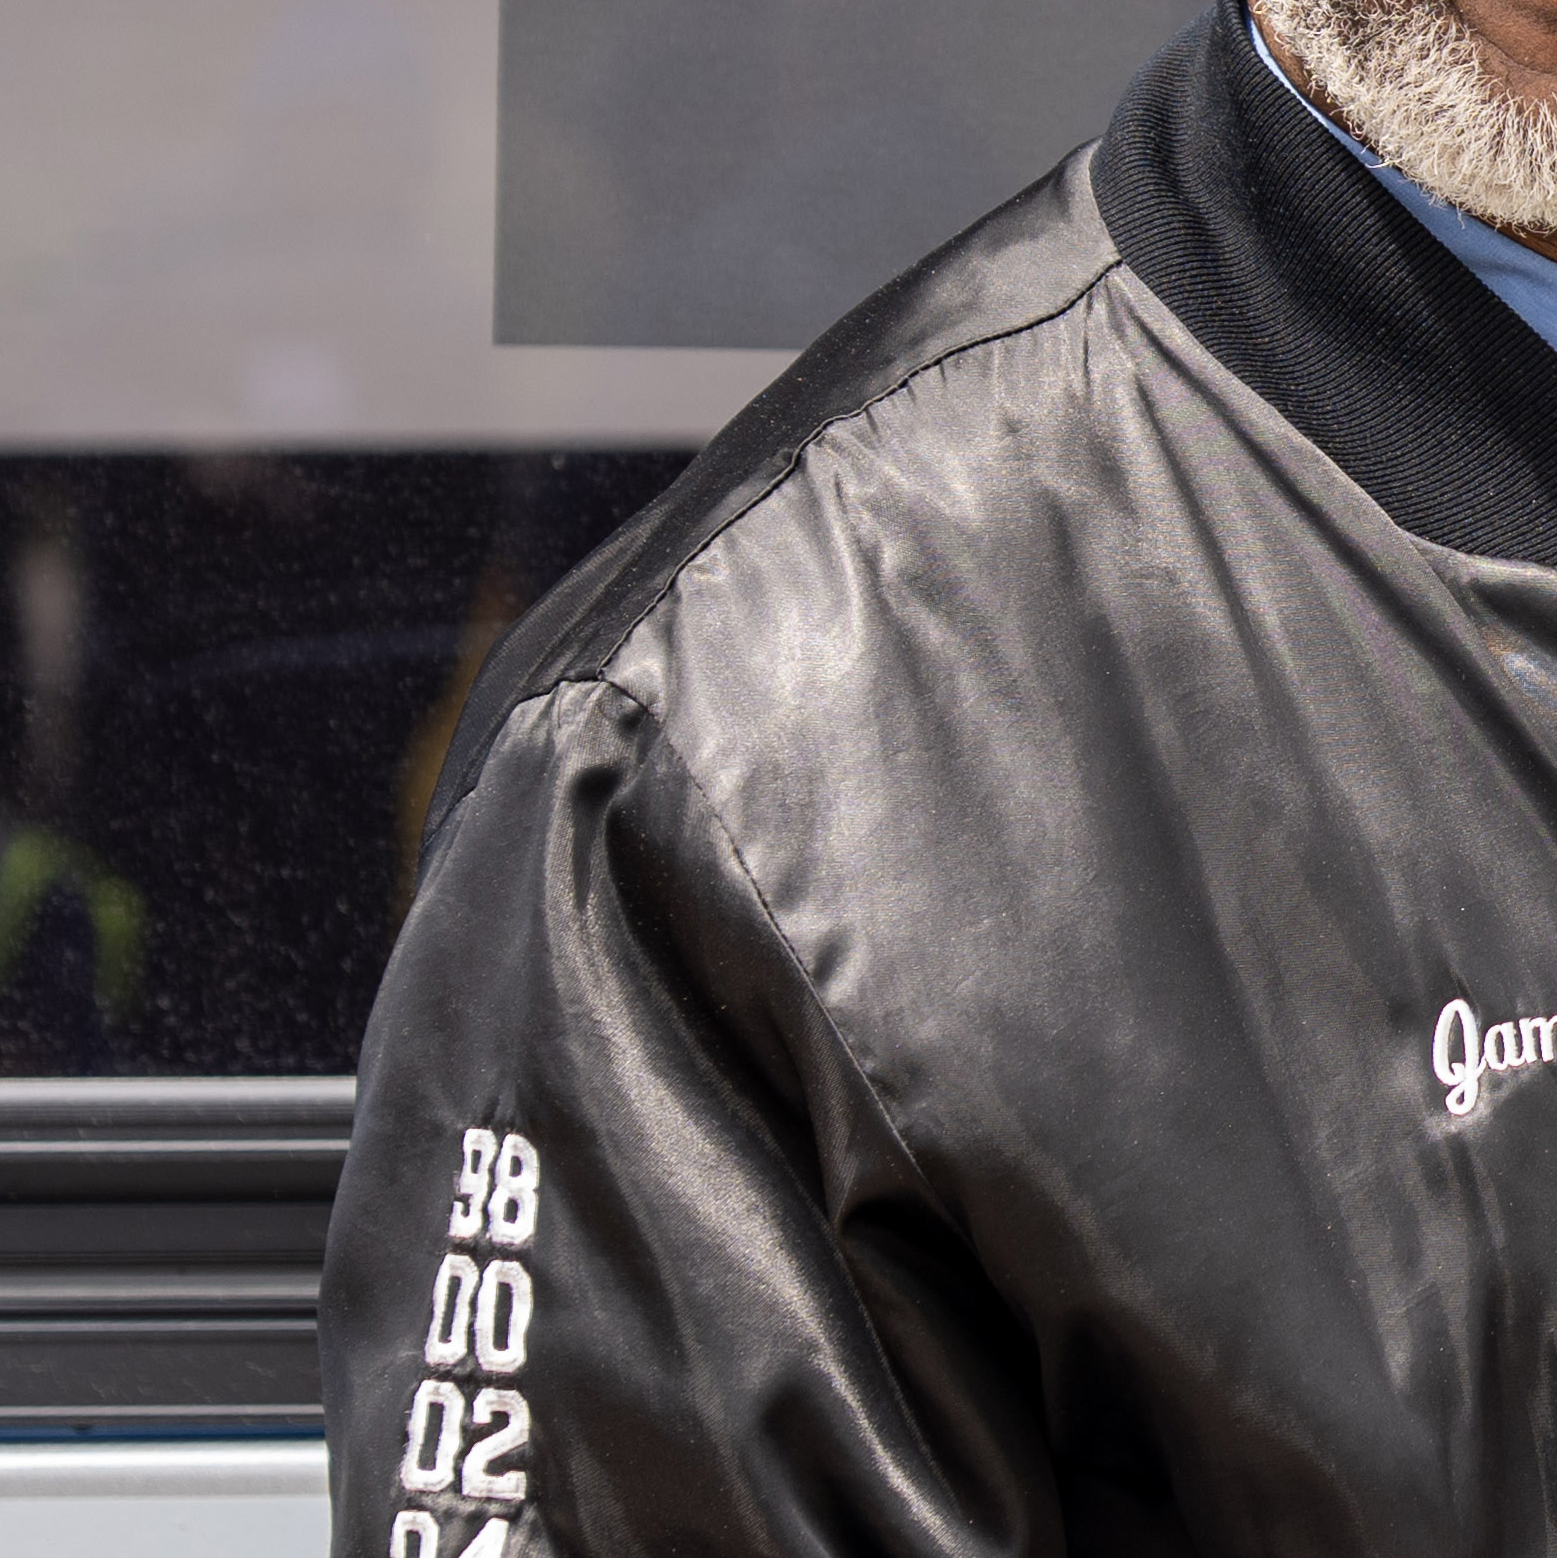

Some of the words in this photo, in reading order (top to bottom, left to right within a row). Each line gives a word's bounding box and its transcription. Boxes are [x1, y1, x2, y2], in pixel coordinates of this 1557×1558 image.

[448, 1127, 540, 1245] 98
[424, 1253, 533, 1374] 00
[401, 1379, 531, 1501] 02
